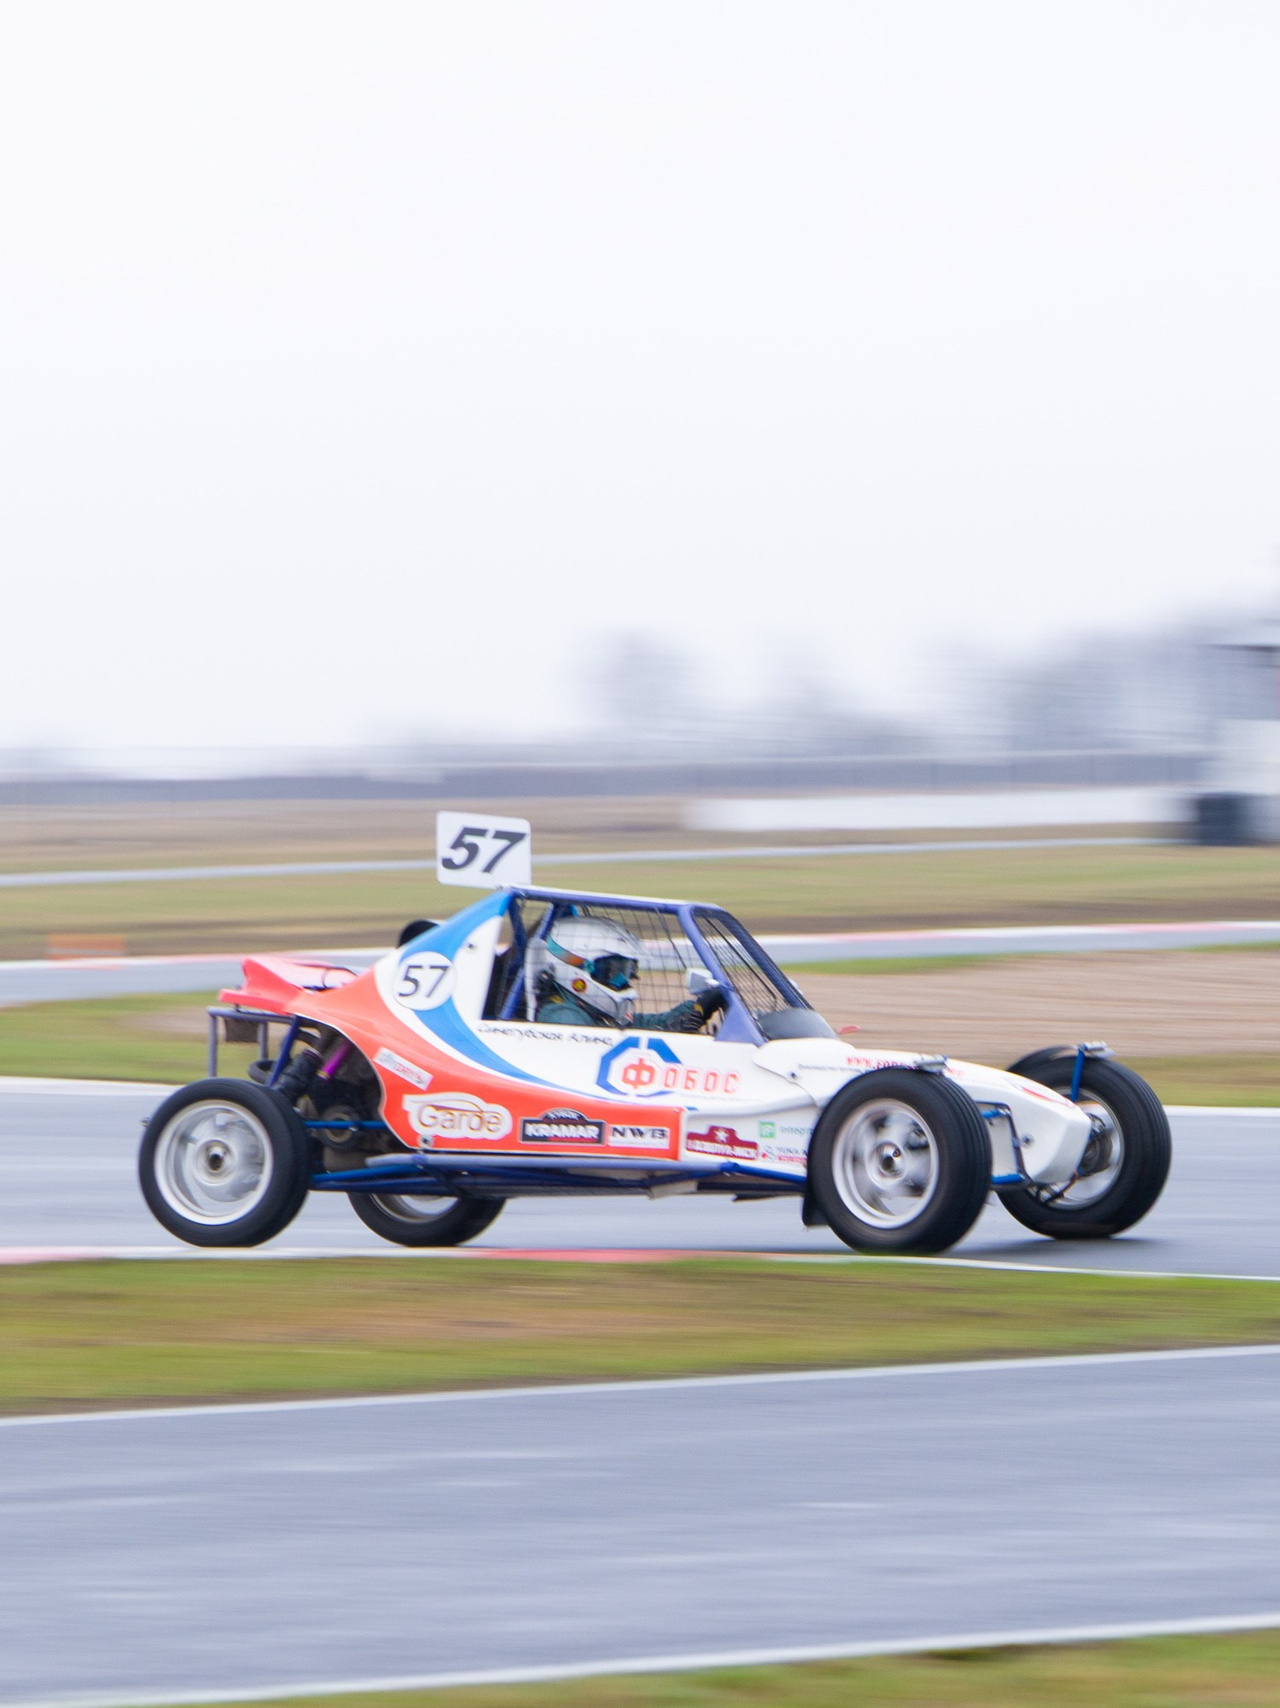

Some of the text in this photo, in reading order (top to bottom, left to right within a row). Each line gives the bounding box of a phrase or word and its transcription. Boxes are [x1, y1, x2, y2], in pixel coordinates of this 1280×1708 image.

[441, 826, 527, 873] 57
[398, 964, 450, 998] 57
[525, 1122, 600, 1139] KRAMAR
